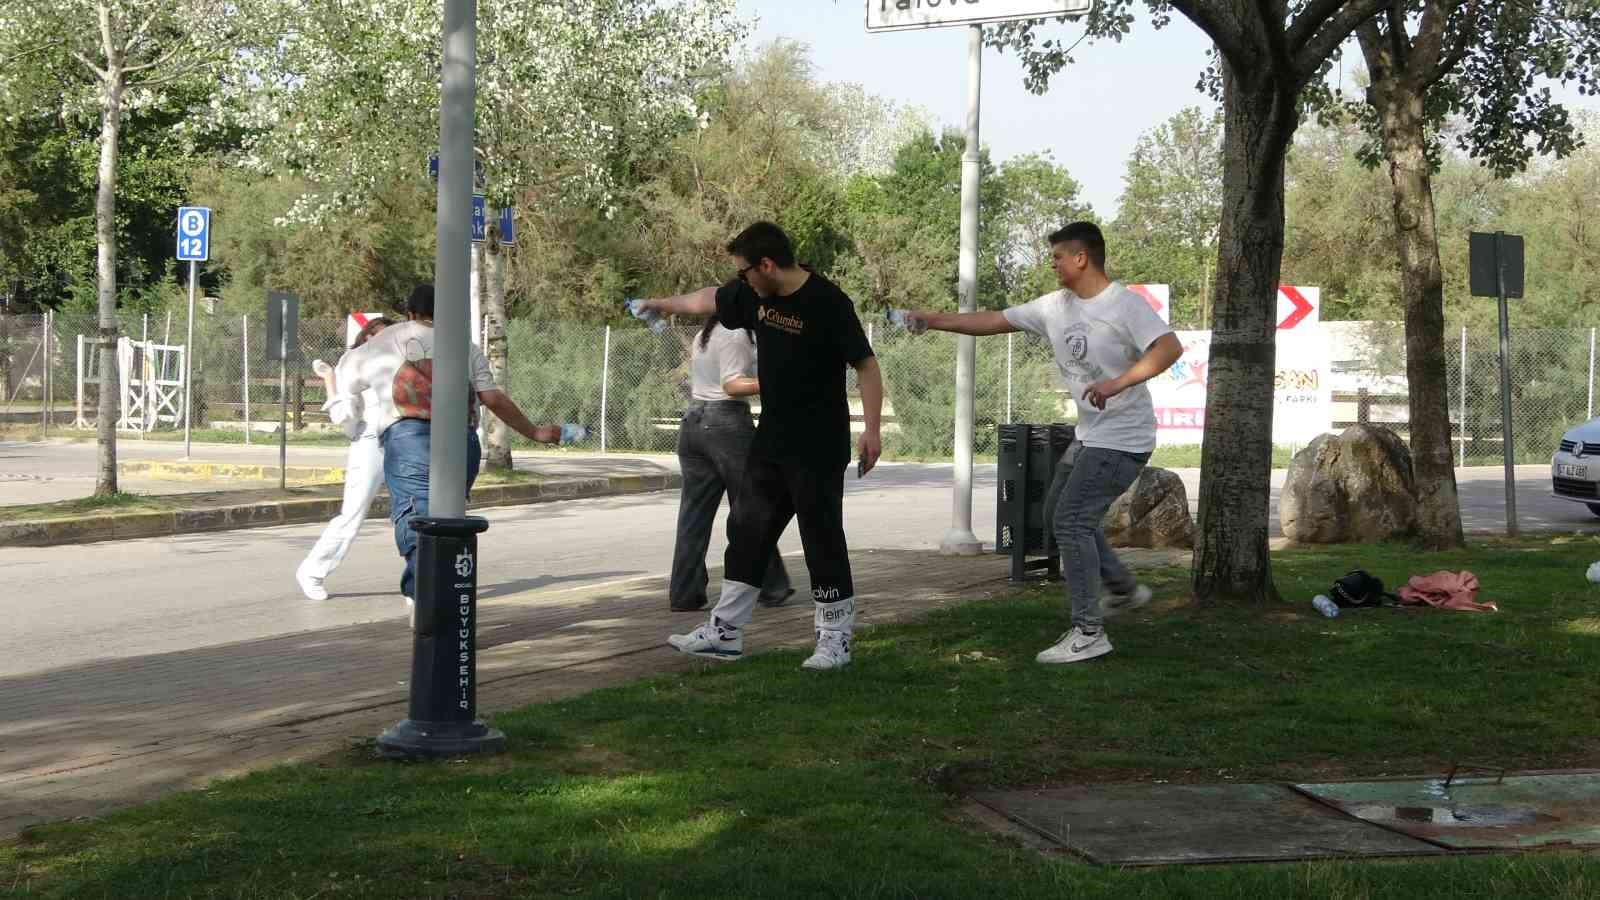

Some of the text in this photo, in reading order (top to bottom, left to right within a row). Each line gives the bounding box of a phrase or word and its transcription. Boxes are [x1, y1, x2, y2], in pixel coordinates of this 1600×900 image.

[188, 215, 199, 231] B
[180, 238, 202, 256] 12
[813, 585, 840, 599] alvin
